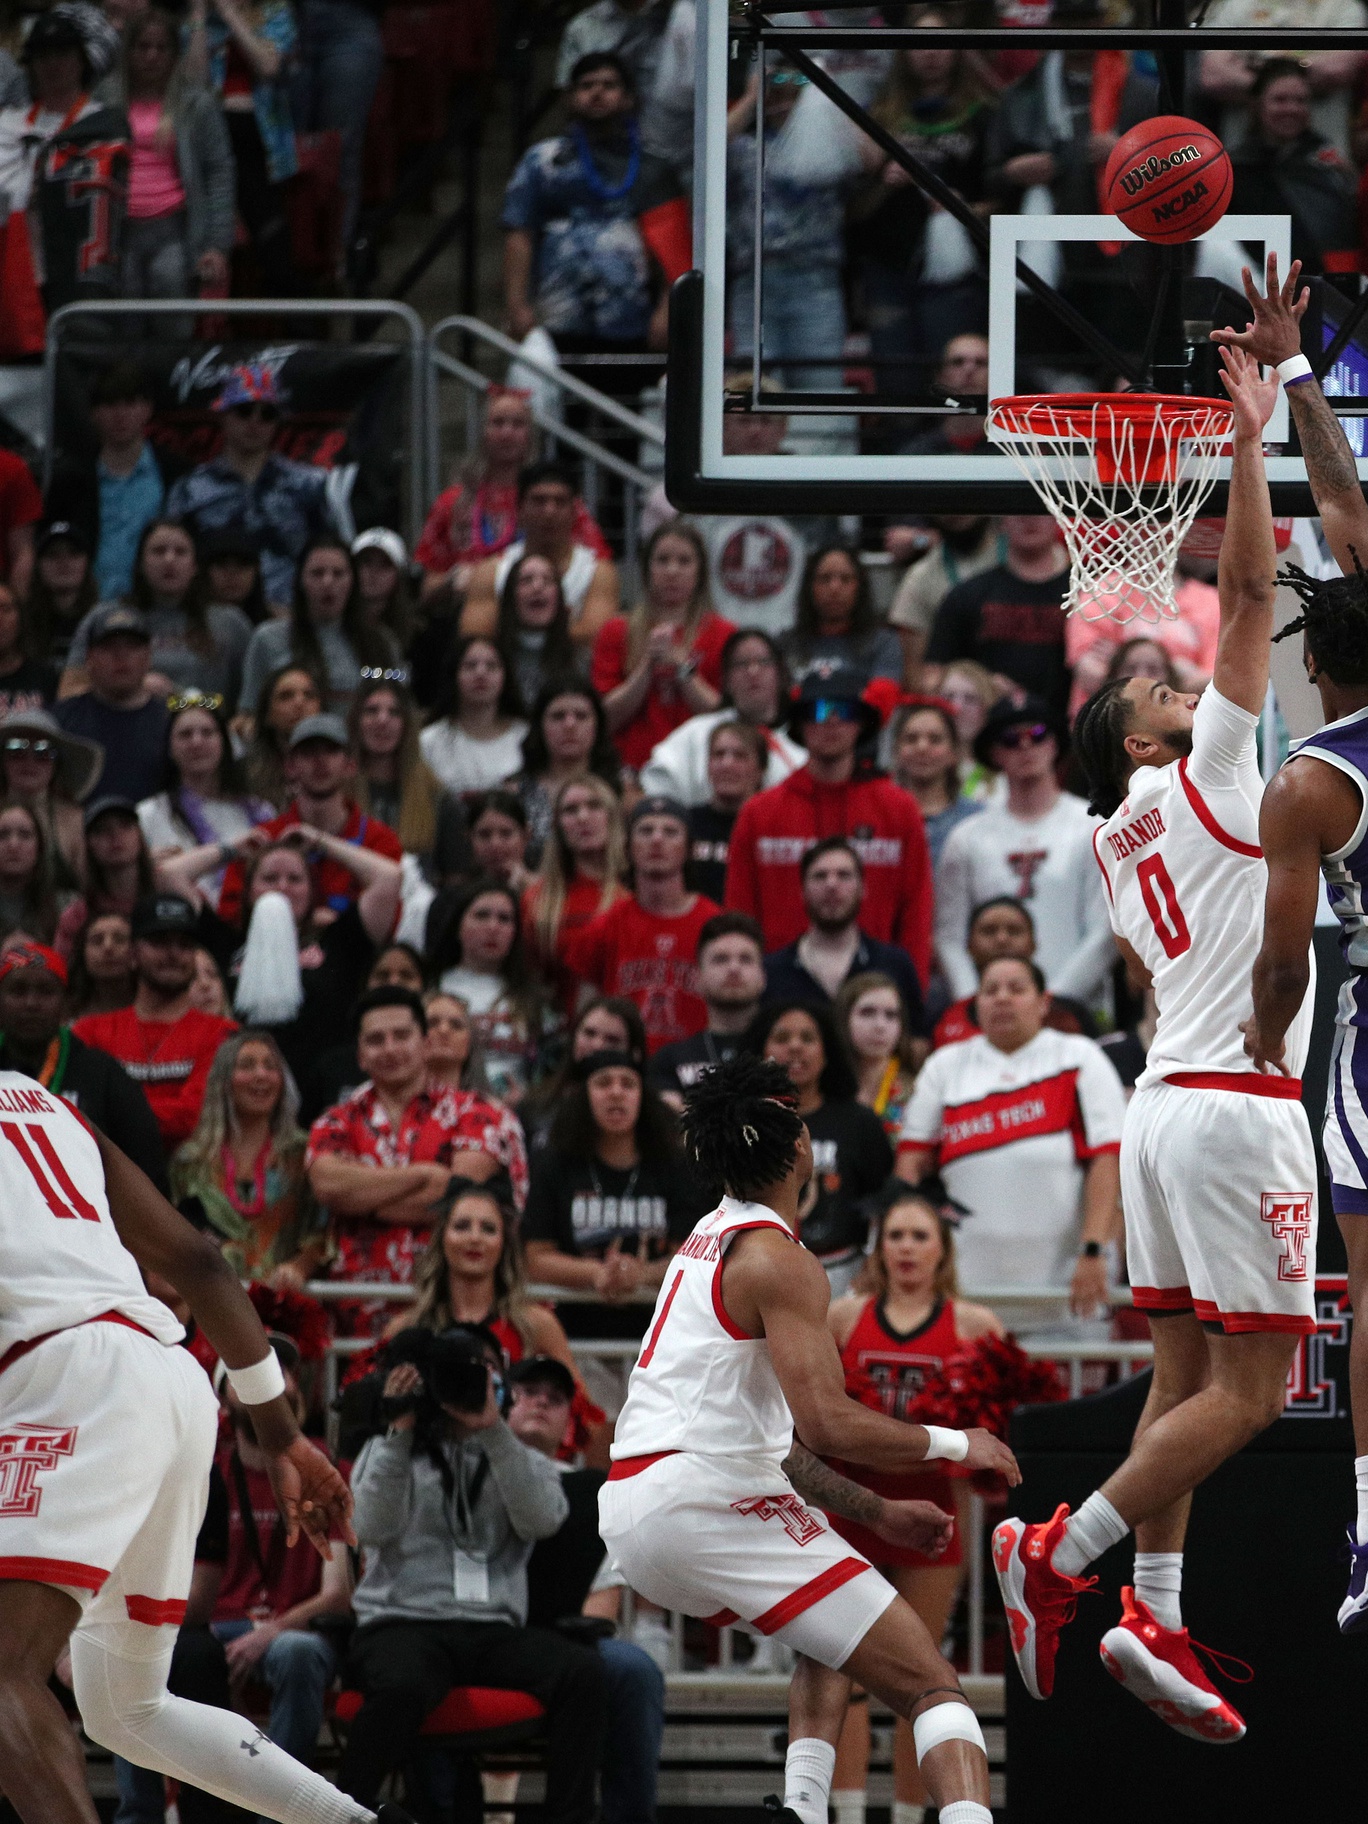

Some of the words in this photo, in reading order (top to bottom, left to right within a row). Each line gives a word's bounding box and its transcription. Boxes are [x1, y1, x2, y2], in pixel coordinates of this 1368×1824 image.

[1119, 144, 1201, 196] Wilson
[1151, 181, 1209, 223] NCAA
[1136, 852, 1192, 960] 0
[0, 1089, 56, 1114] LIAMS
[996, 1097, 1046, 1131] TECH
[0, 1121, 101, 1222] 11
[637, 1269, 685, 1369] 1
